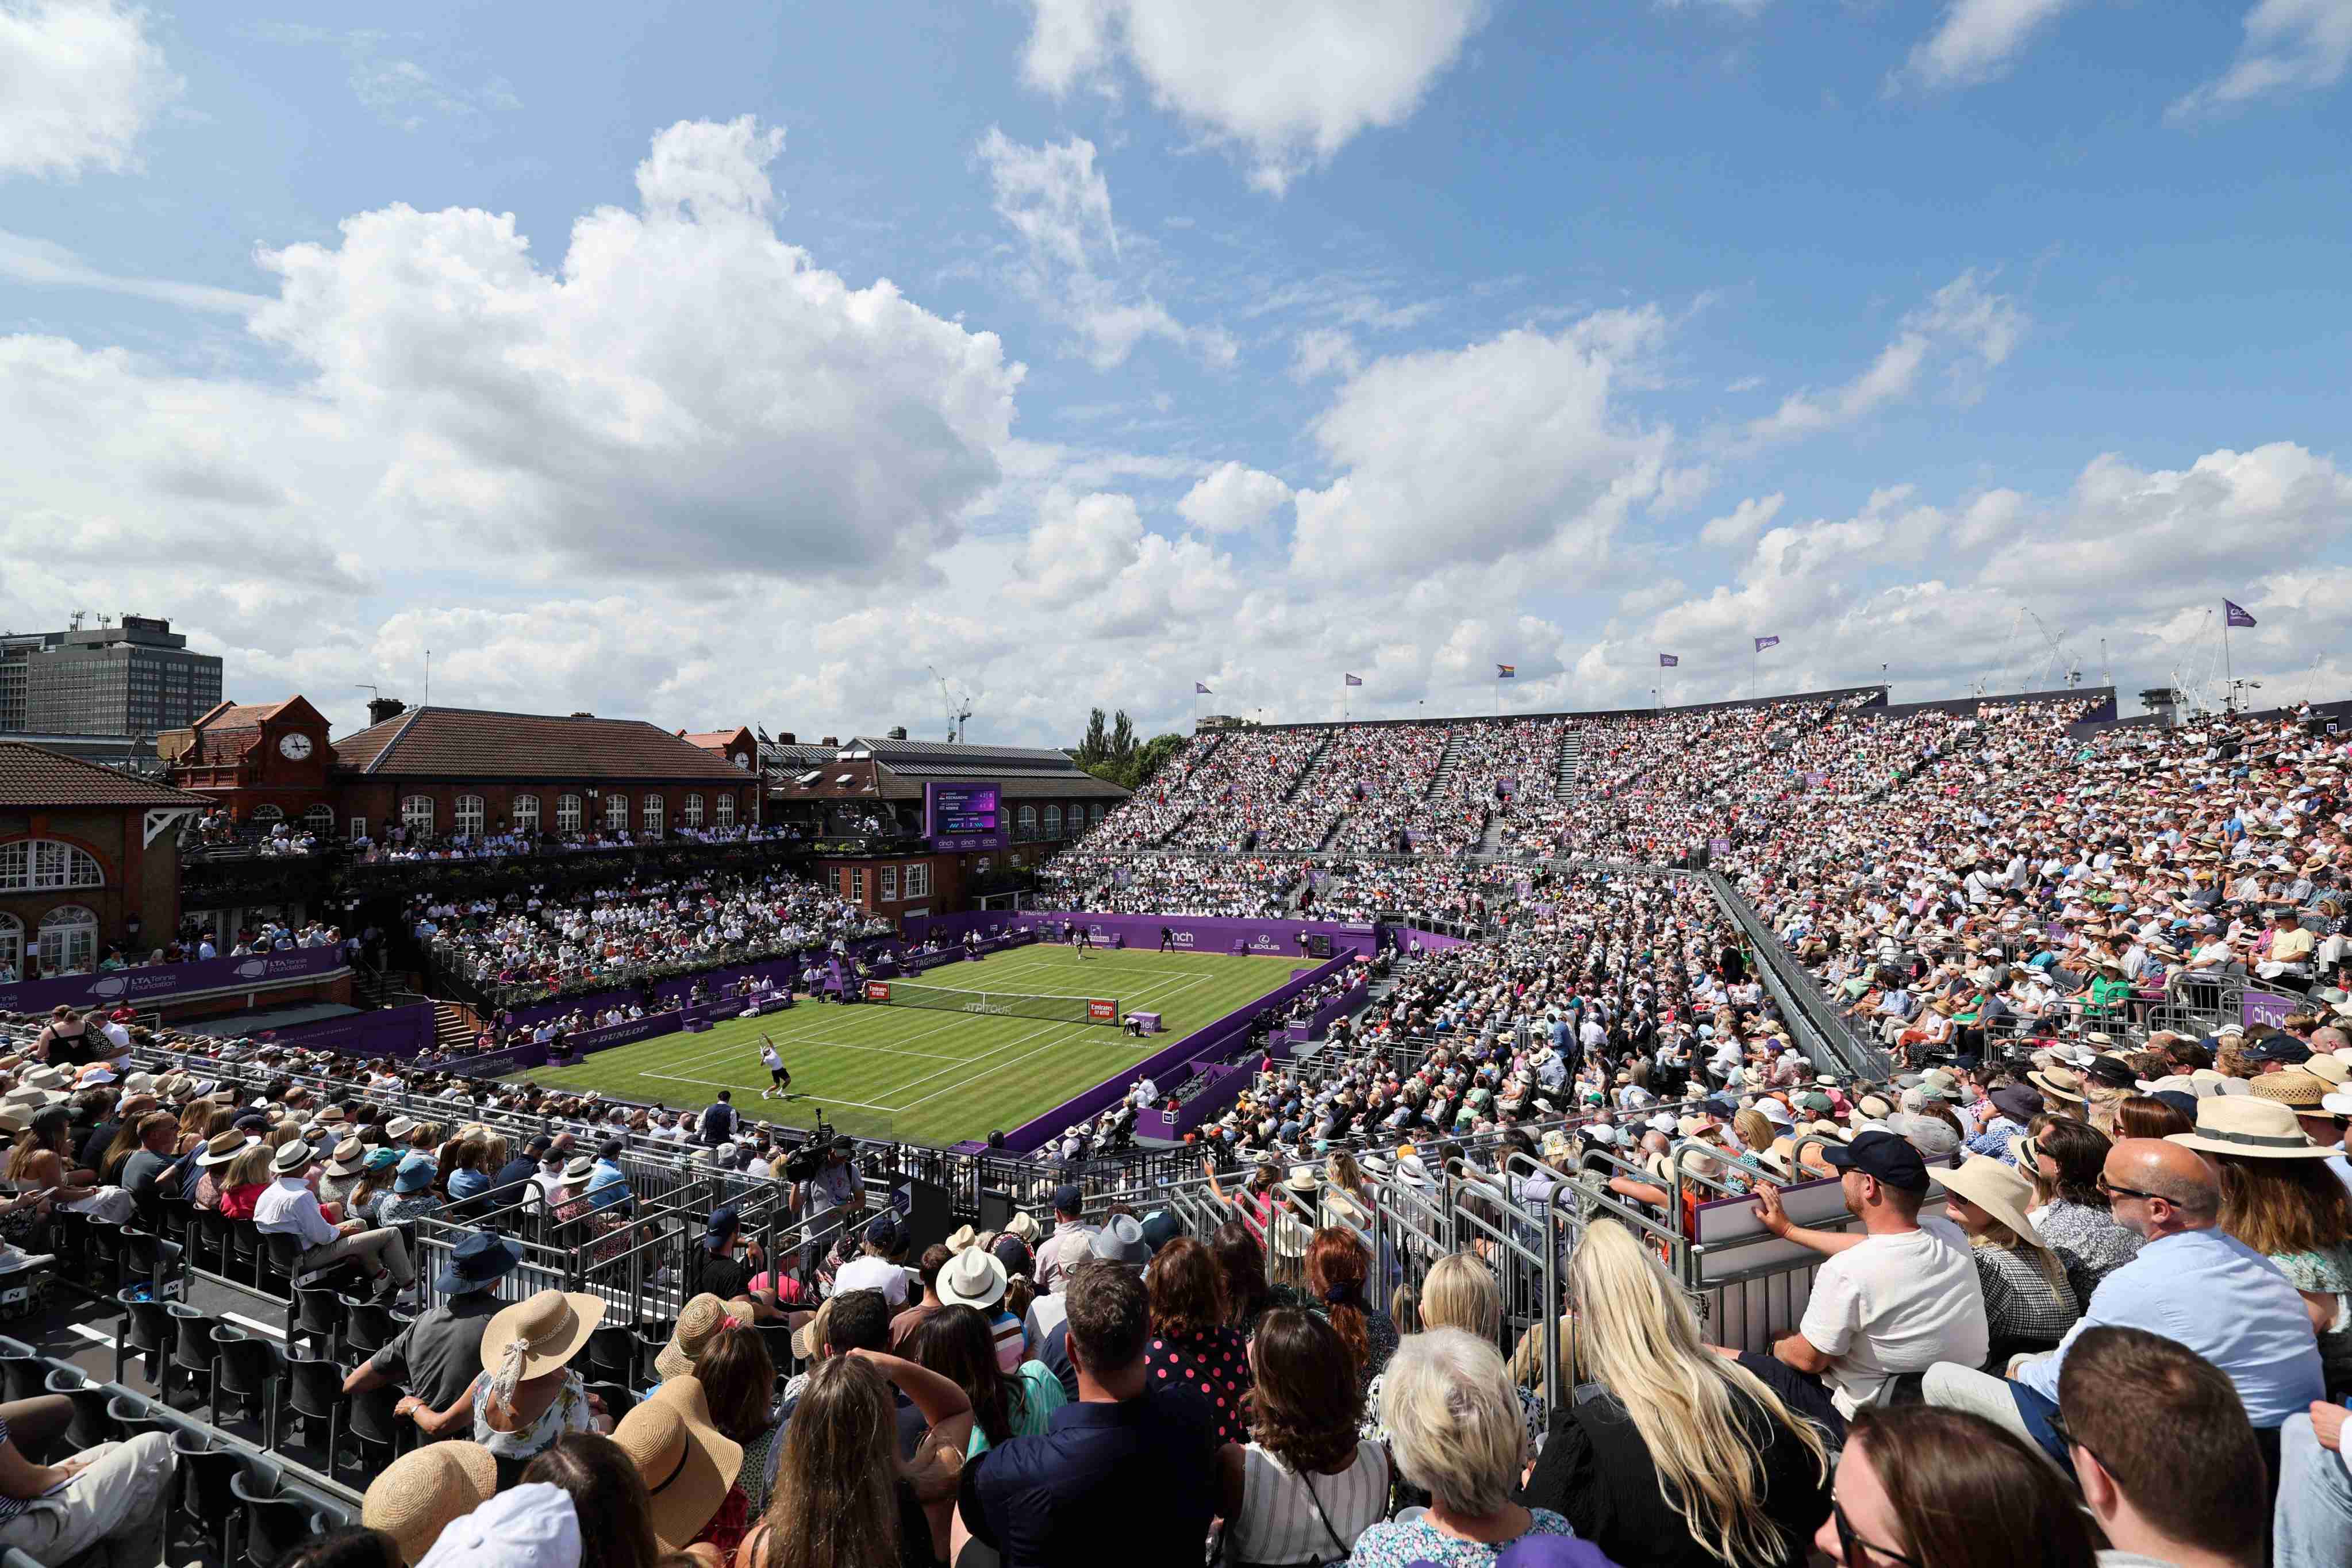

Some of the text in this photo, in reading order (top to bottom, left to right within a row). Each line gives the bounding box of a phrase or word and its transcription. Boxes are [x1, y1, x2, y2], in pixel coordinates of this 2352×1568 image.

[269, 963, 308, 973] Foundation
[270, 959, 286, 967] LTA
[132, 974, 176, 985] LTA Tennis
[131, 980, 176, 991] Foundation
[963, 1002, 1012, 1016] ATP TOUR
[598, 1025, 649, 1043] DUNLOP
[168, 1283, 179, 1292] M
[9, 1291, 20, 1300] N
